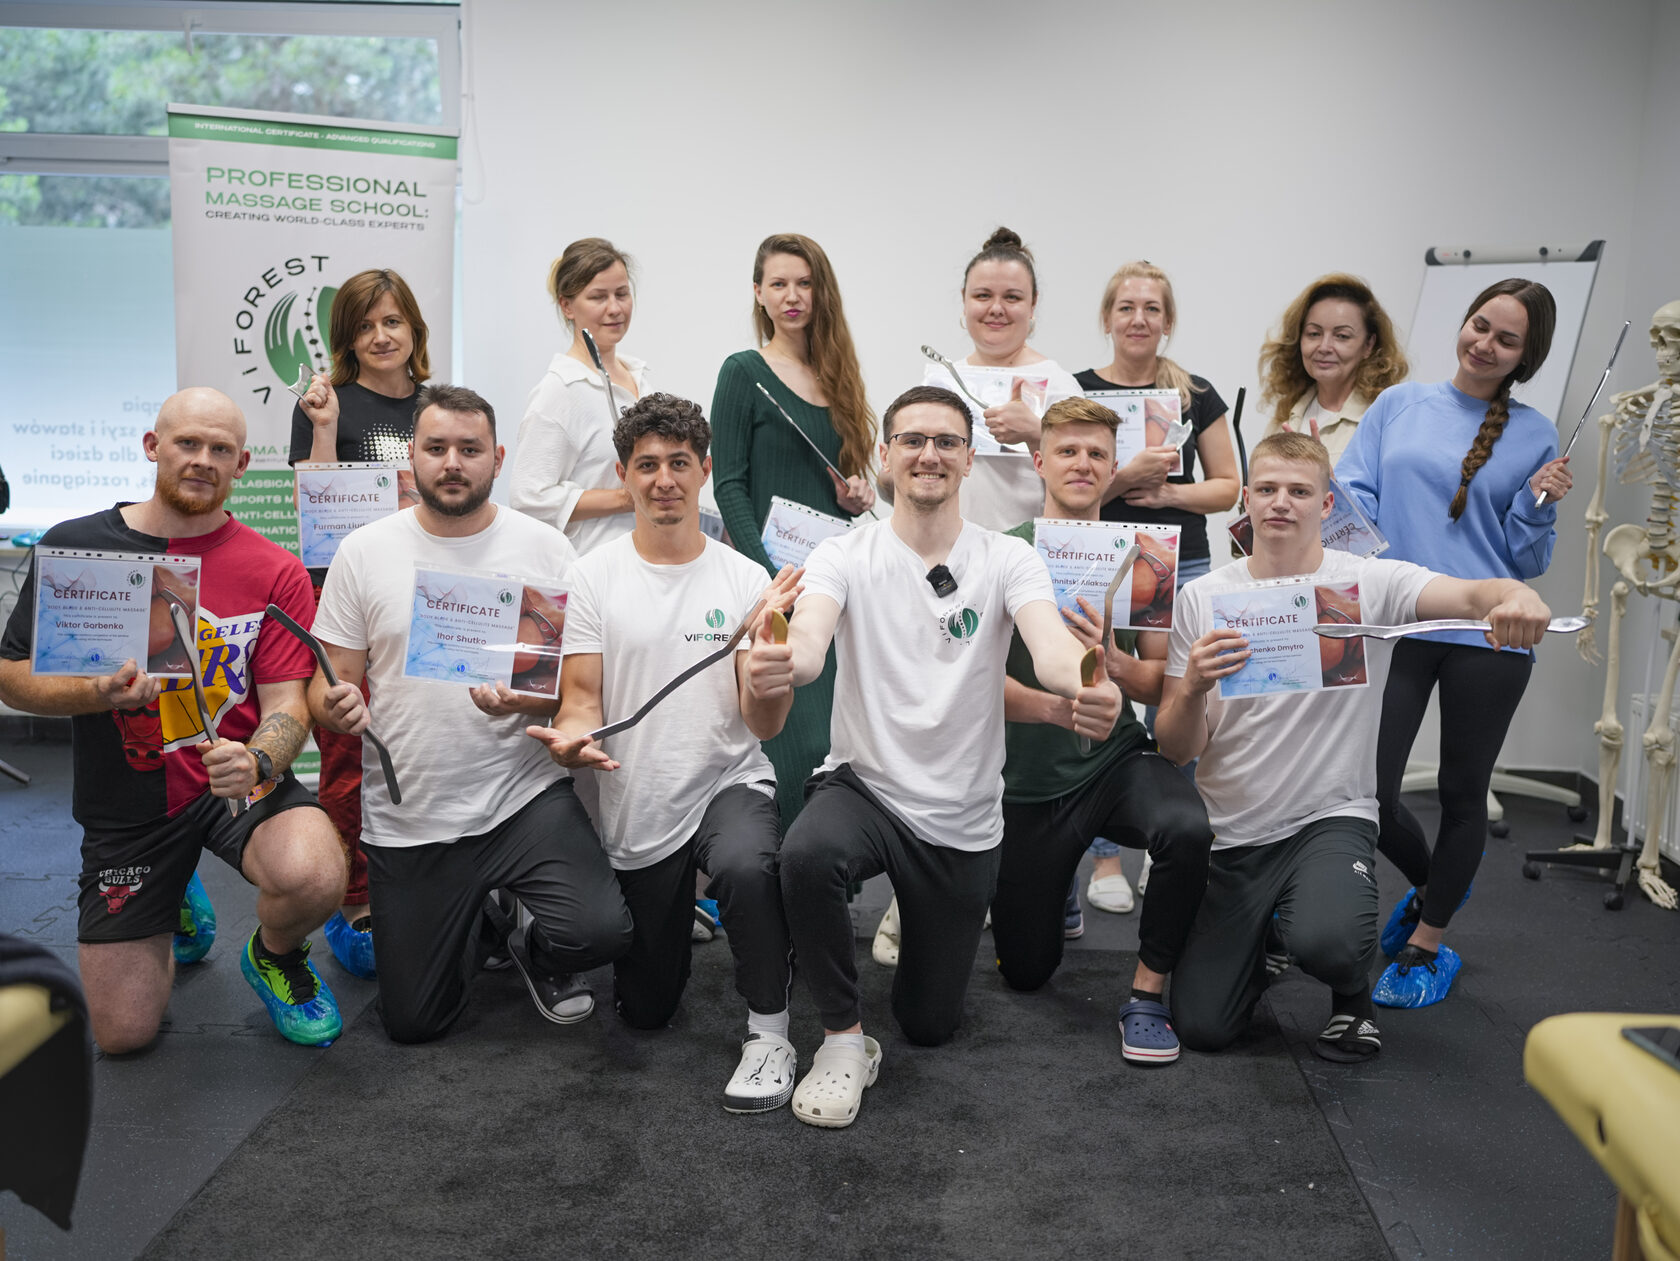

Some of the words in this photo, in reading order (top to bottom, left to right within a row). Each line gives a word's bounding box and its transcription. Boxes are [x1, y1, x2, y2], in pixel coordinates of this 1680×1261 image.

[194, 122, 264, 135] INTERNATIONAL
[265, 128, 319, 139] CERTIFICATE
[326, 133, 370, 144] ADVANCED
[371, 137, 436, 149] QUALIFICATIONS
[206, 166, 428, 198] PROFESSIONAL
[205, 190, 323, 212] MASSAGE
[330, 200, 430, 218] SCHOOL:
[205, 210, 270, 222] CREATING
[274, 214, 366, 228] WORLD-CLASS
[368, 220, 426, 231] EXPERTS
[230, 495, 282, 504] SPORTS
[308, 493, 380, 504] CERTIFICATE
[1048, 550, 1116, 562] CERTIFICATE
[54, 589, 132, 601] CERTIFICATE
[426, 600, 500, 618] CERTIFICATE
[83, 622, 124, 630] Garbenko
[1226, 614, 1298, 628] CERTIFICATE
[437, 632, 454, 640] Ihor
[456, 634, 487, 645] Shutko
[684, 633, 732, 642] VIFORE
[1278, 644, 1304, 652] Dmytro
[98, 866, 151, 878] CHICAGO
[104, 874, 140, 884] BULLS
